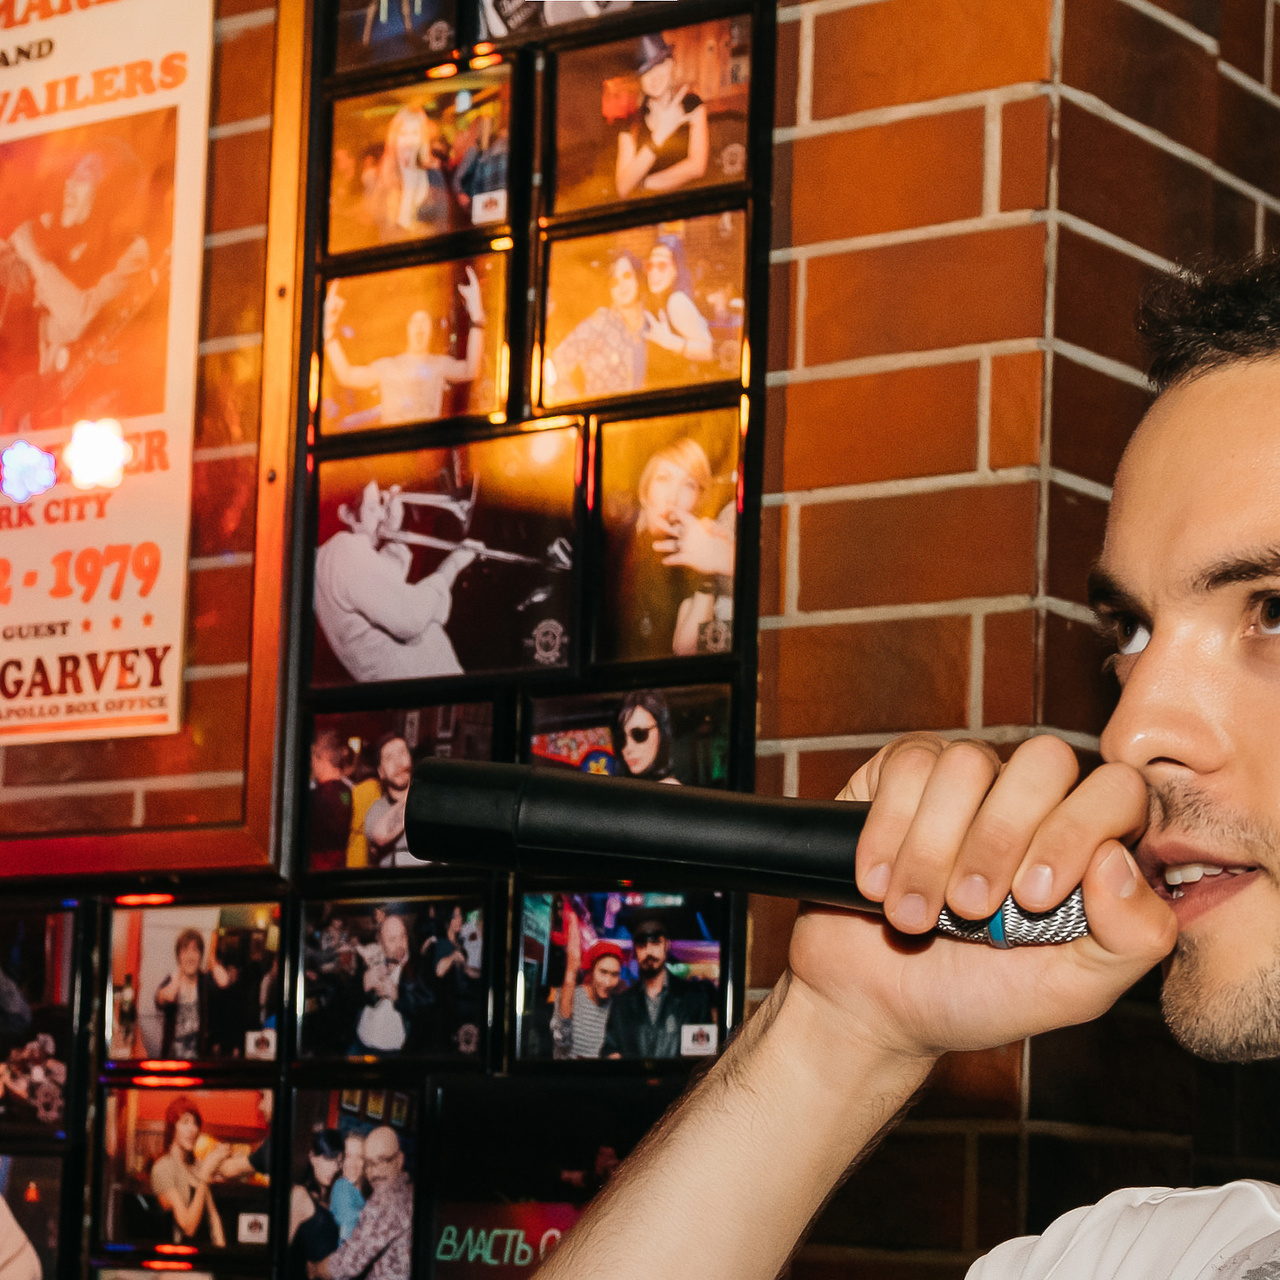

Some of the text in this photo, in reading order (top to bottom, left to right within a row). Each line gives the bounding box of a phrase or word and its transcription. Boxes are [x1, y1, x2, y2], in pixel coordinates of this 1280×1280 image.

[43, 492, 113, 526] CITY
[49, 541, 162, 604] 1979
[2, 620, 71, 641] GUEST
[0, 644, 173, 700] GARVEY
[64, 701, 100, 715] BOX
[435, 1224, 534, 1266] ВЛАСТЬ
